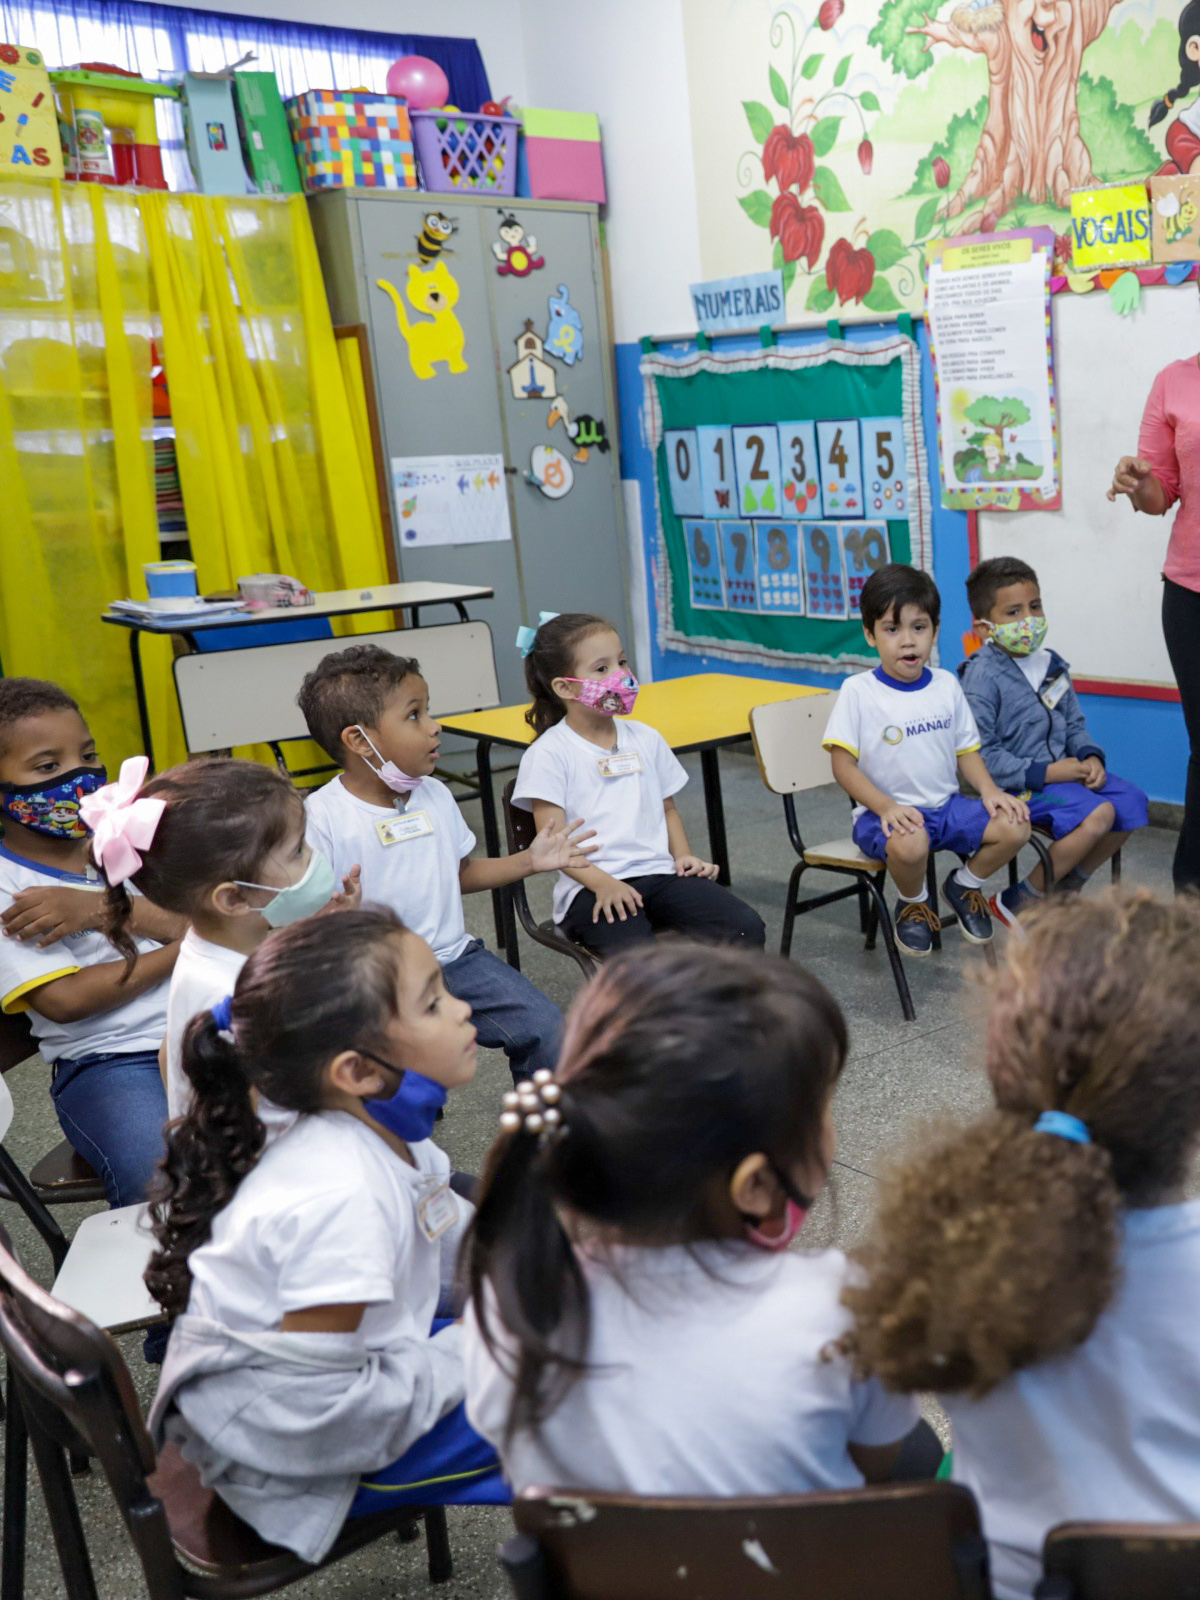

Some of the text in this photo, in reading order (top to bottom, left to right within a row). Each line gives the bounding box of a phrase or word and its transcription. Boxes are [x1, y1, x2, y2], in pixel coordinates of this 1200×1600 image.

[1072, 209, 1150, 249] VOGAIS
[693, 284, 781, 321] NUMERAIS
[676, 428, 894, 482] 0 1 2 3 4 5
[693, 527, 887, 574] 6 7 8 9 10
